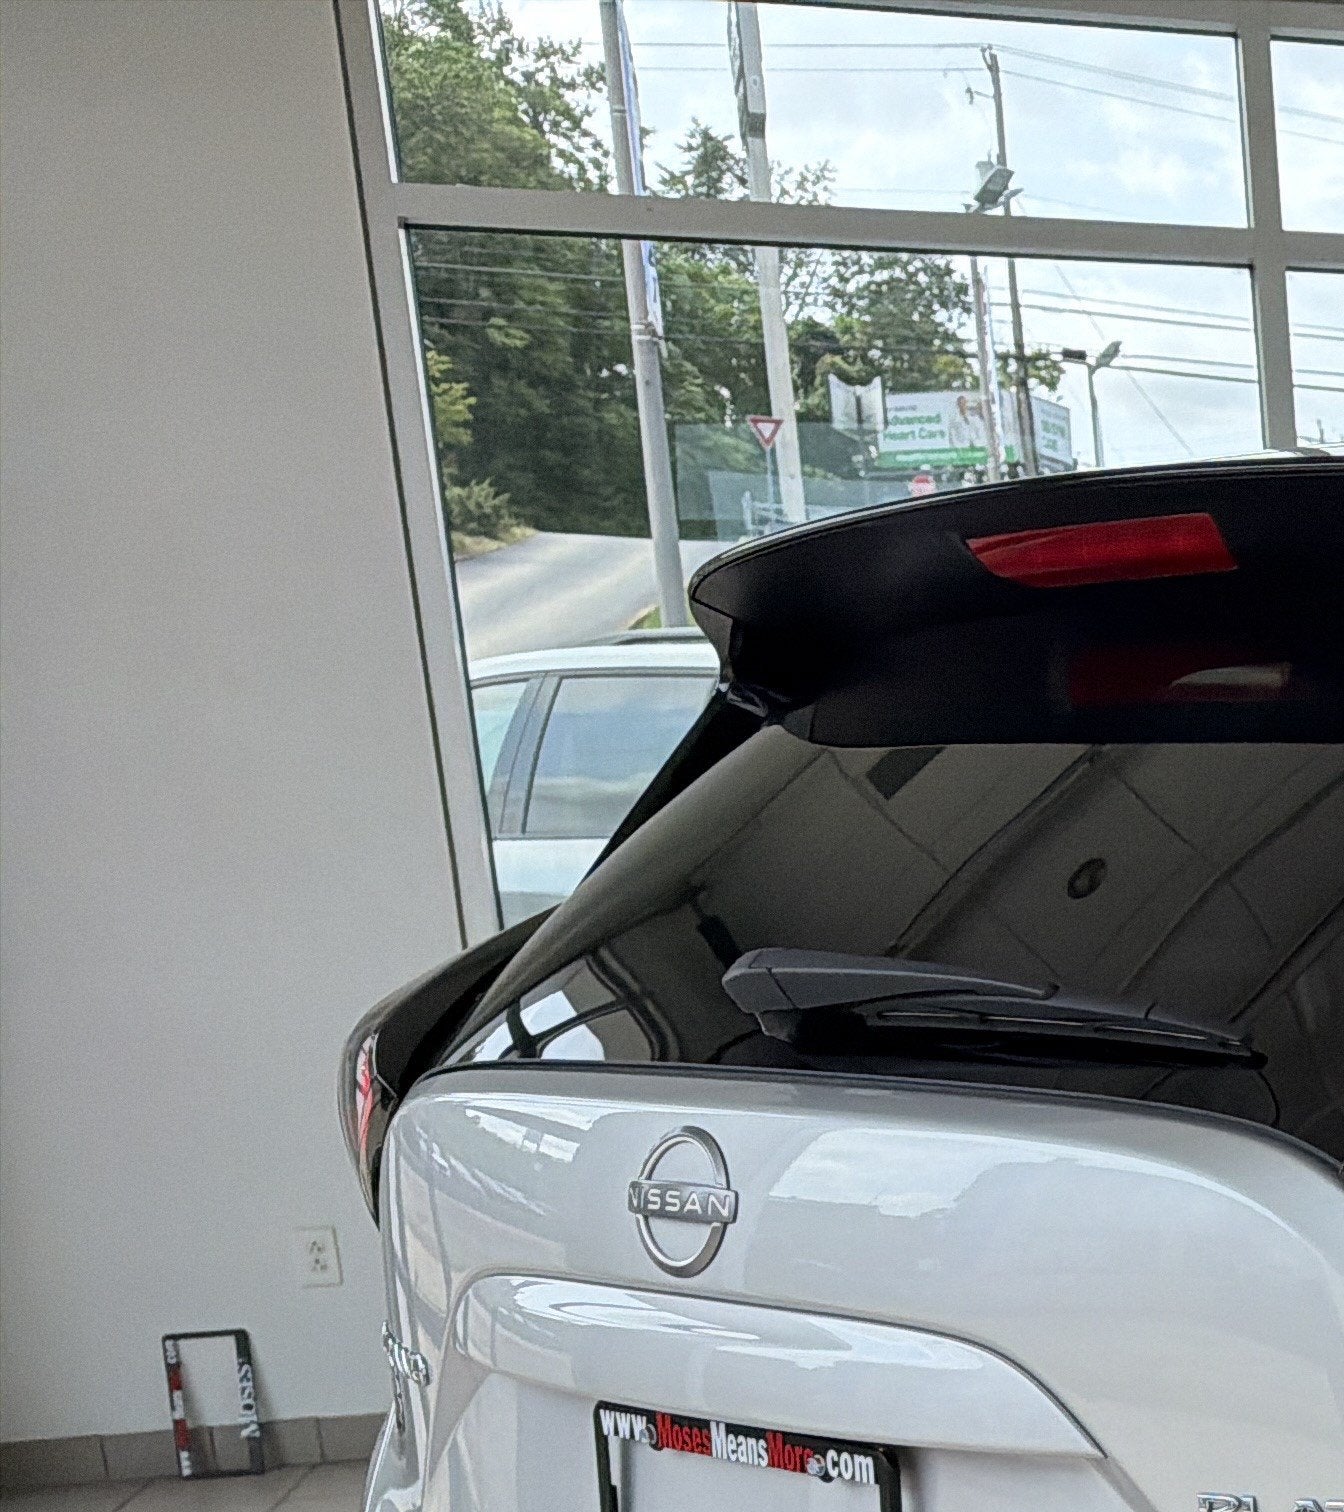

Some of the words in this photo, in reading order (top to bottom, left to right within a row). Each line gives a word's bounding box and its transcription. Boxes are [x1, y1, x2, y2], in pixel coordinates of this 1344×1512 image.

[888, 413, 942, 426] dvanced
[629, 1187, 730, 1217] NISSAN
[599, 1409, 876, 1486] wwwMosesMeansMorcom
